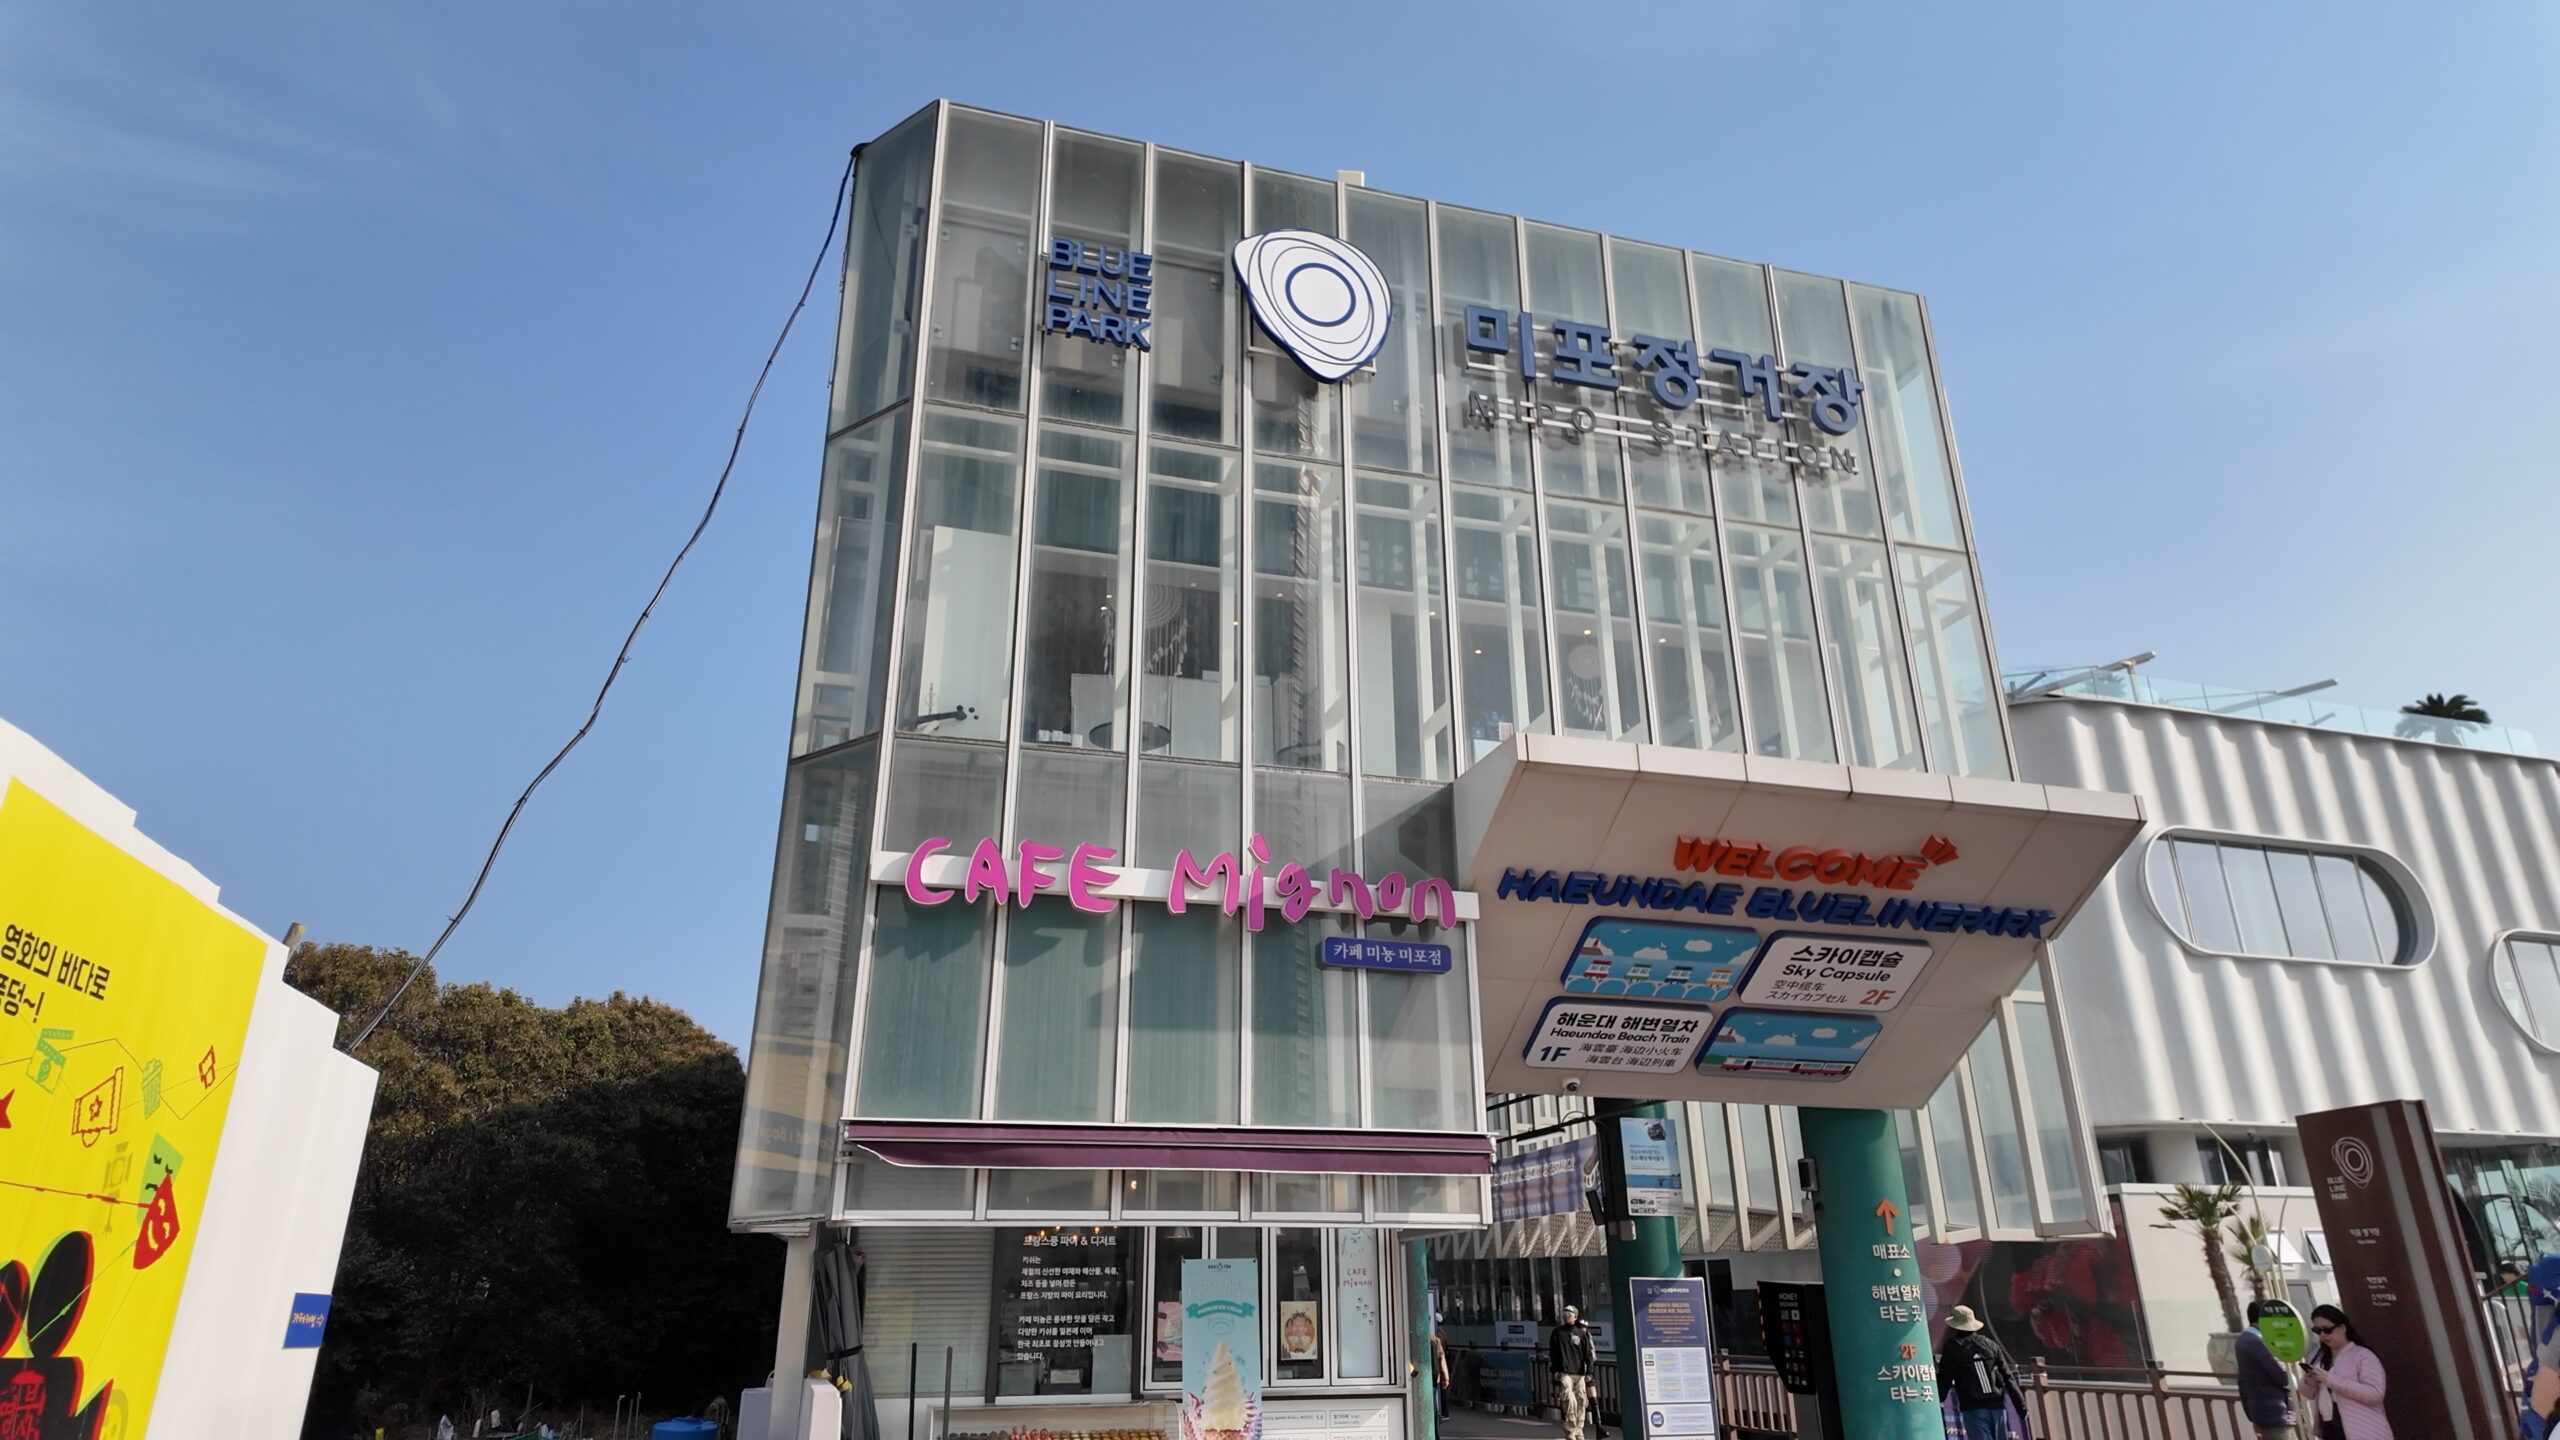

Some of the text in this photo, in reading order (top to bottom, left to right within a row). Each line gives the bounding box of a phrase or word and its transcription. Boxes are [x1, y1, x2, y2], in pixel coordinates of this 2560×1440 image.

[1049, 237, 1152, 286] BLUE
[1048, 271, 1152, 318] LINE
[1046, 303, 1152, 353] PARK
[1464, 304, 1864, 436] 미포정거장
[1468, 390, 1859, 475] MIPO STATION
[1673, 834, 1929, 891] WELCOME
[904, 832, 1456, 932] CAFE Mignon
[1497, 866, 2057, 939] HAEUNDAE BLUELINEPARK
[1, 923, 111, 1001] 영화의 바다로
[1333, 942, 1363, 961] 카페
[1398, 946, 1441, 966] 미포점
[1790, 945, 1904, 969] 스카이캡슐
[1782, 964, 1892, 983] Sky Capsule
[1858, 989, 1896, 1005] 2F
[1557, 1012, 1699, 1033] 해운대 해변열차
[1550, 1028, 1691, 1044] Haeundae Beach Train
[1540, 1046, 1571, 1062] 1F
[2326, 1175, 2345, 1185] BLUE
[2328, 1184, 2347, 1193] LINE
[1022, 1235, 1059, 1247] 프랑스풍
[1080, 1235, 1089, 1246] &
[1090, 1235, 1118, 1247] 디저트
[1872, 1244, 1911, 1260] 매표소
[1346, 1267, 1368, 1276] CAFE
[1778, 1292, 1798, 1301] MONEY
[1871, 1285, 1921, 1301] 해변열차
[1879, 1305, 1922, 1322] 타는 곳
[1900, 1343, 1918, 1359] 2F
[1922, 1385, 1934, 1402] 곳
